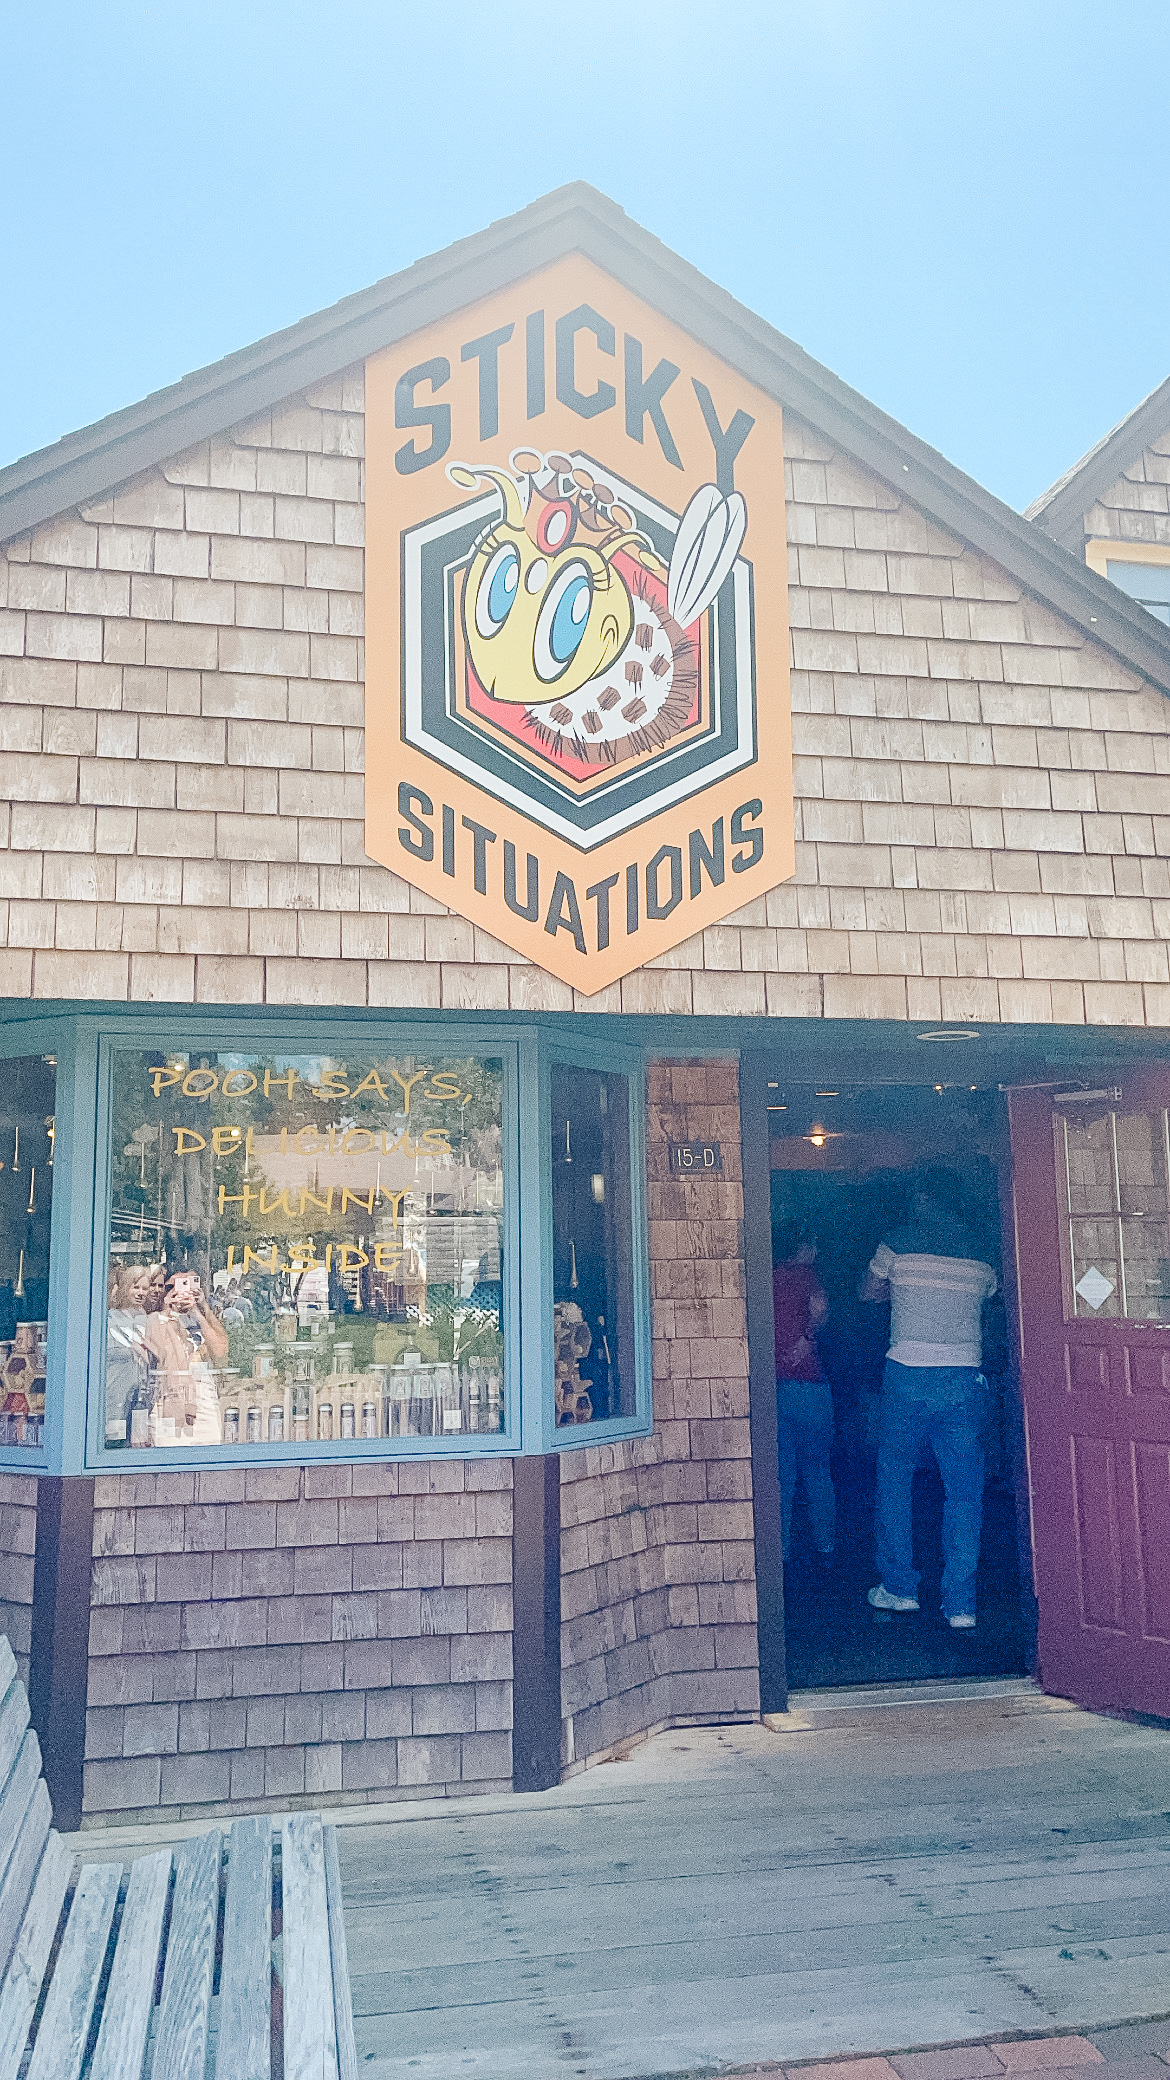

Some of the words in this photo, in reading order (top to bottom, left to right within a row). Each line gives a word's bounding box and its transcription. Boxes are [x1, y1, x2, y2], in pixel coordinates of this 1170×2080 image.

[394, 303, 756, 498] STICKY
[397, 781, 764, 956] SITUATIONS
[148, 1066, 301, 1101] POOH
[312, 1069, 473, 1114] SAYS,
[171, 1125, 452, 1160] DELICIOUS
[677, 1148, 715, 1167] 15-D
[217, 1184, 414, 1230] HUNNY
[226, 1241, 404, 1276] INSIDE
